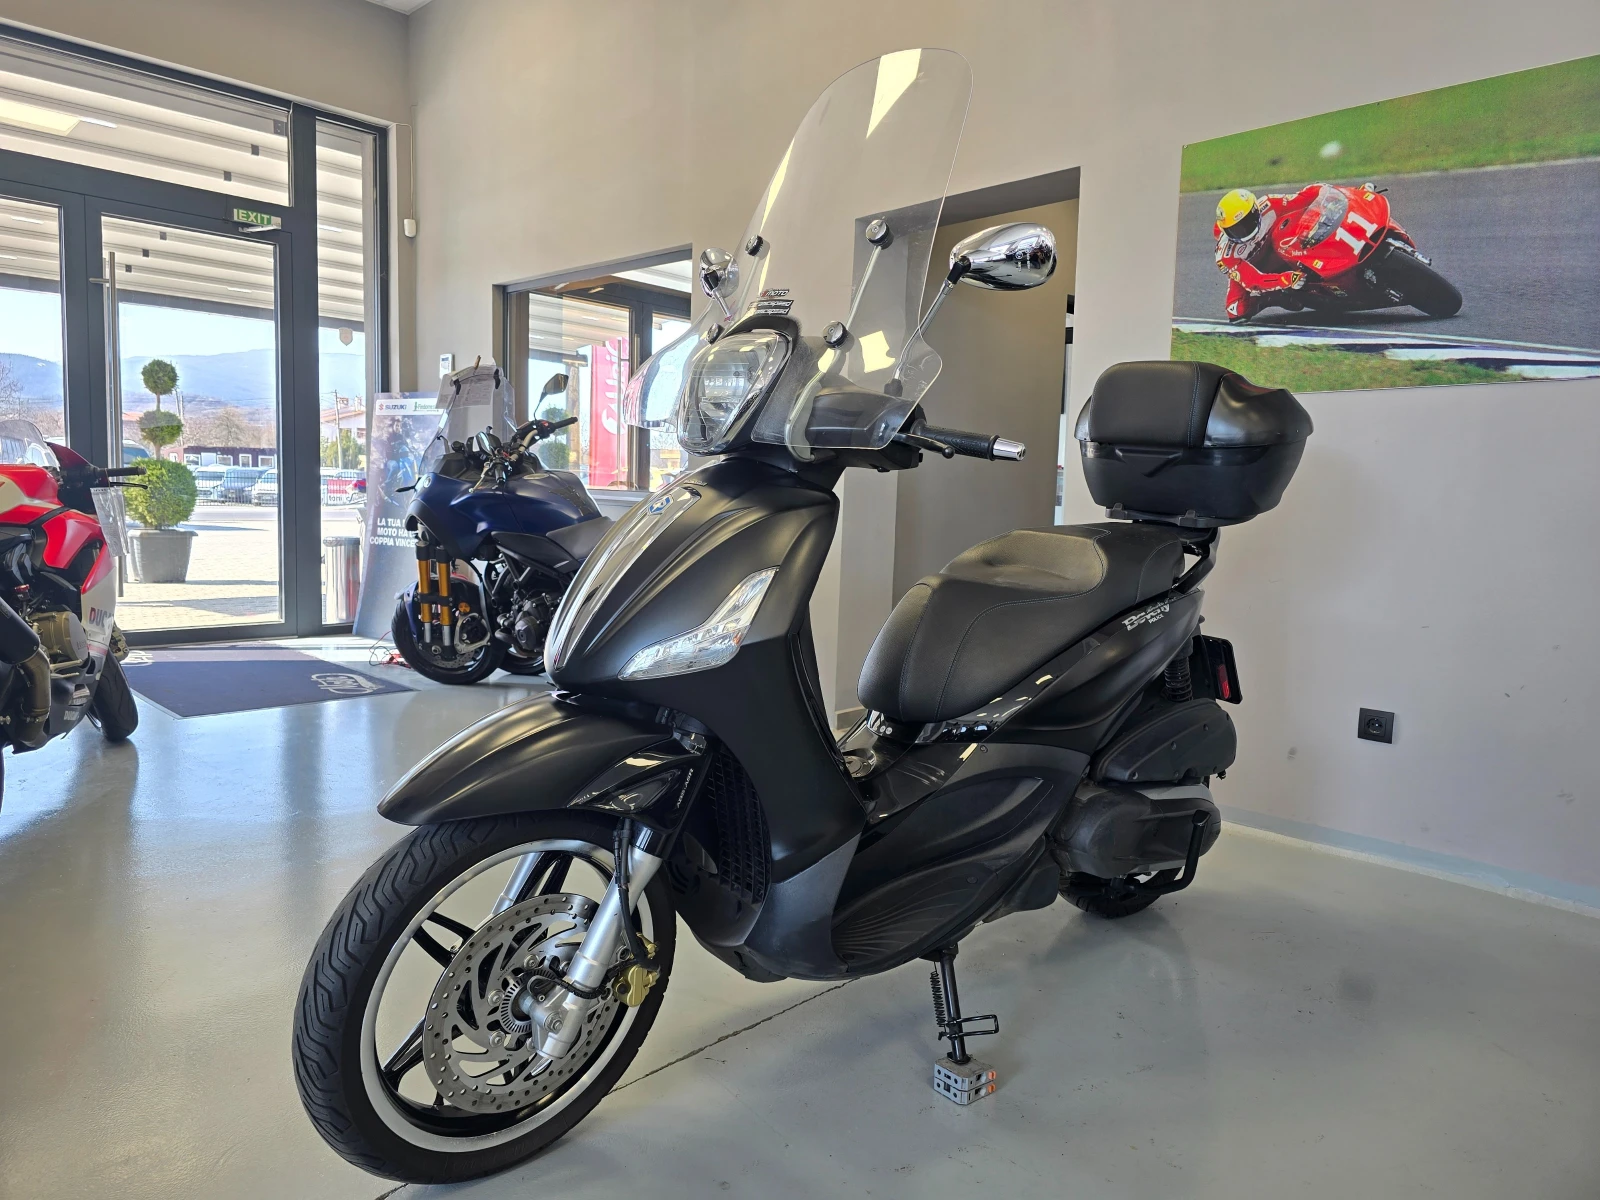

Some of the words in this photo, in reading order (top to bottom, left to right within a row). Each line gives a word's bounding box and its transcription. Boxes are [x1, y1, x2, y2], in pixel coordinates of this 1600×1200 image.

[238, 209, 270, 225] EXIT
[1335, 211, 1378, 255] 11
[377, 517, 386, 526] LA
[387, 518, 401, 528] TUA
[377, 527, 397, 537] MOTO
[398, 529, 408, 538] HA
[369, 536, 394, 546] COPPIA
[395, 538, 417, 548] VINCE
